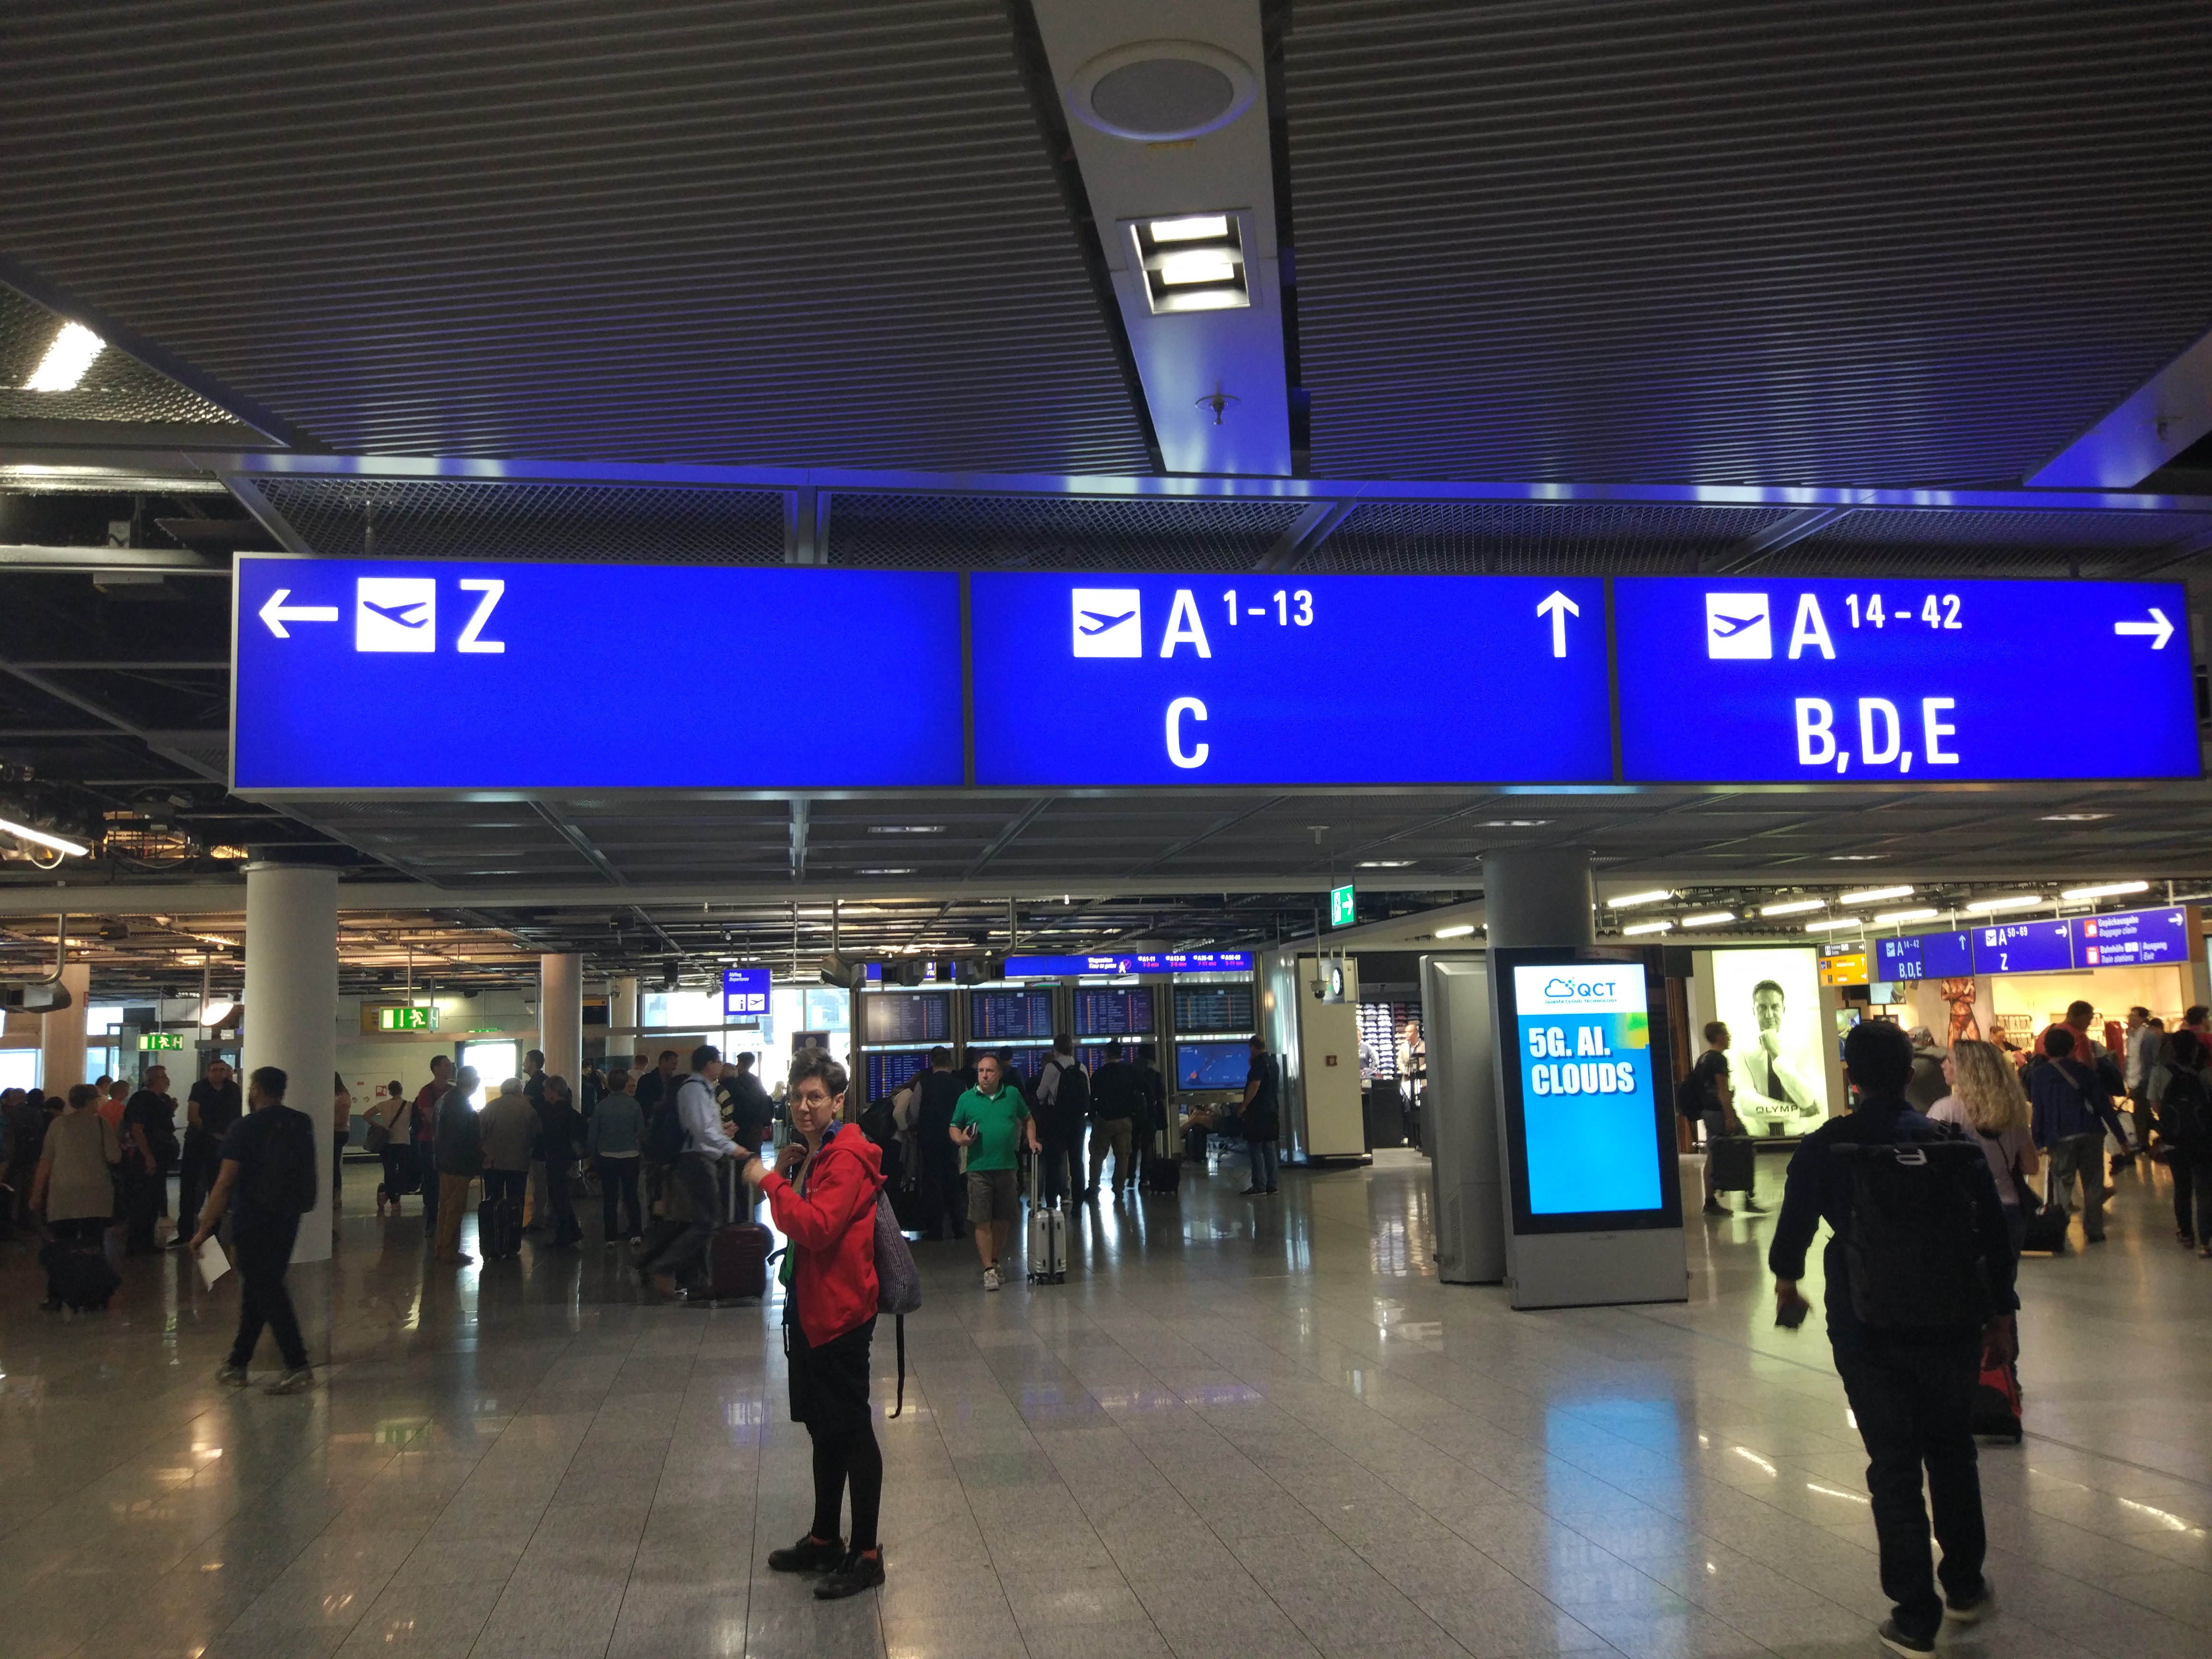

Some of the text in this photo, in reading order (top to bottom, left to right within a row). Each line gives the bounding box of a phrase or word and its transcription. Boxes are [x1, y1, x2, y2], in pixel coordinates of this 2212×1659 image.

[457, 579, 505, 653] Z
[1160, 589, 1212, 658] A
[1788, 593, 1836, 660] A
[1166, 697, 1209, 769] C
[1897, 941, 1904, 957] A
[1998, 928, 2008, 946] A
[2000, 953, 2008, 971] Z
[1577, 983, 1616, 997] QCT
[1531, 1061, 1635, 1096] CLOUDS
[1756, 1105, 1798, 1114] OLYMP
